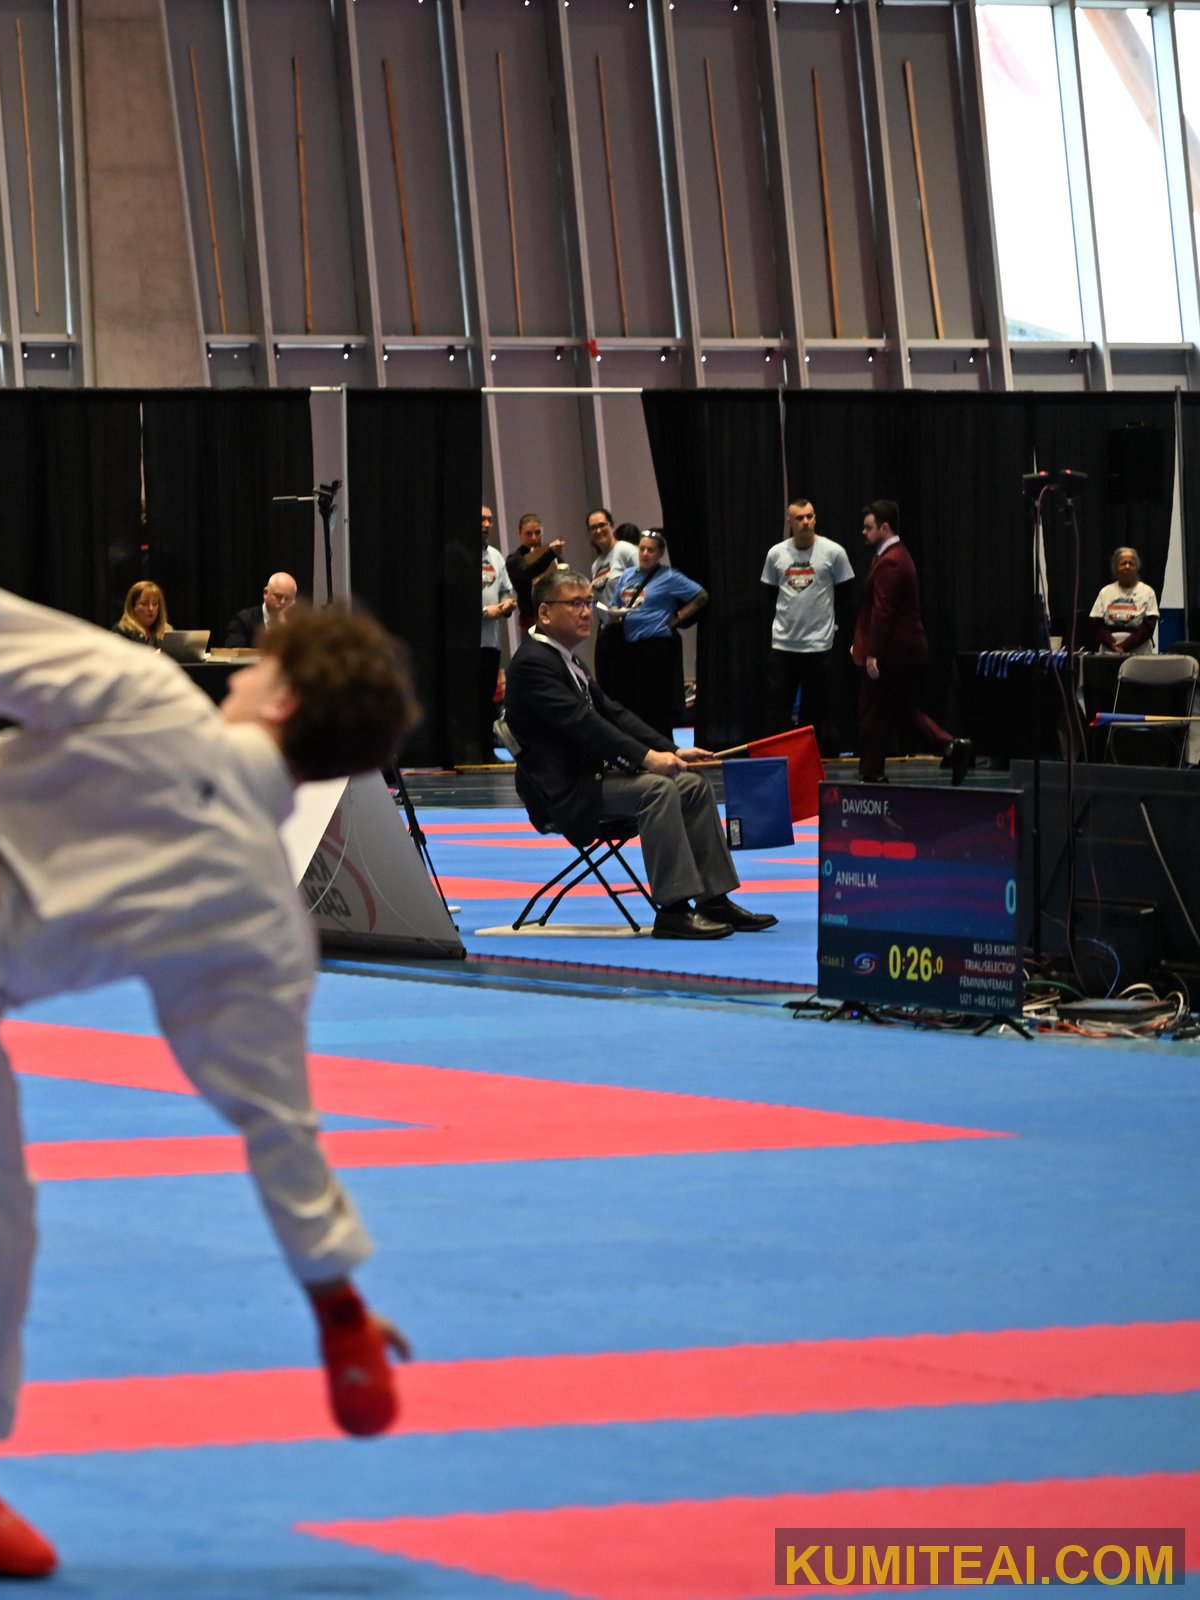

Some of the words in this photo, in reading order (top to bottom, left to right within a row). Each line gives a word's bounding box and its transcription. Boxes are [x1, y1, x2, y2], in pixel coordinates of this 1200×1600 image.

[842, 797, 882, 815] DAVISON
[883, 800, 891, 816] F.
[1008, 803, 1016, 840] 1
[834, 870, 866, 888] ANHILL
[867, 872, 879, 889] M.
[1005, 879, 1017, 916] 0
